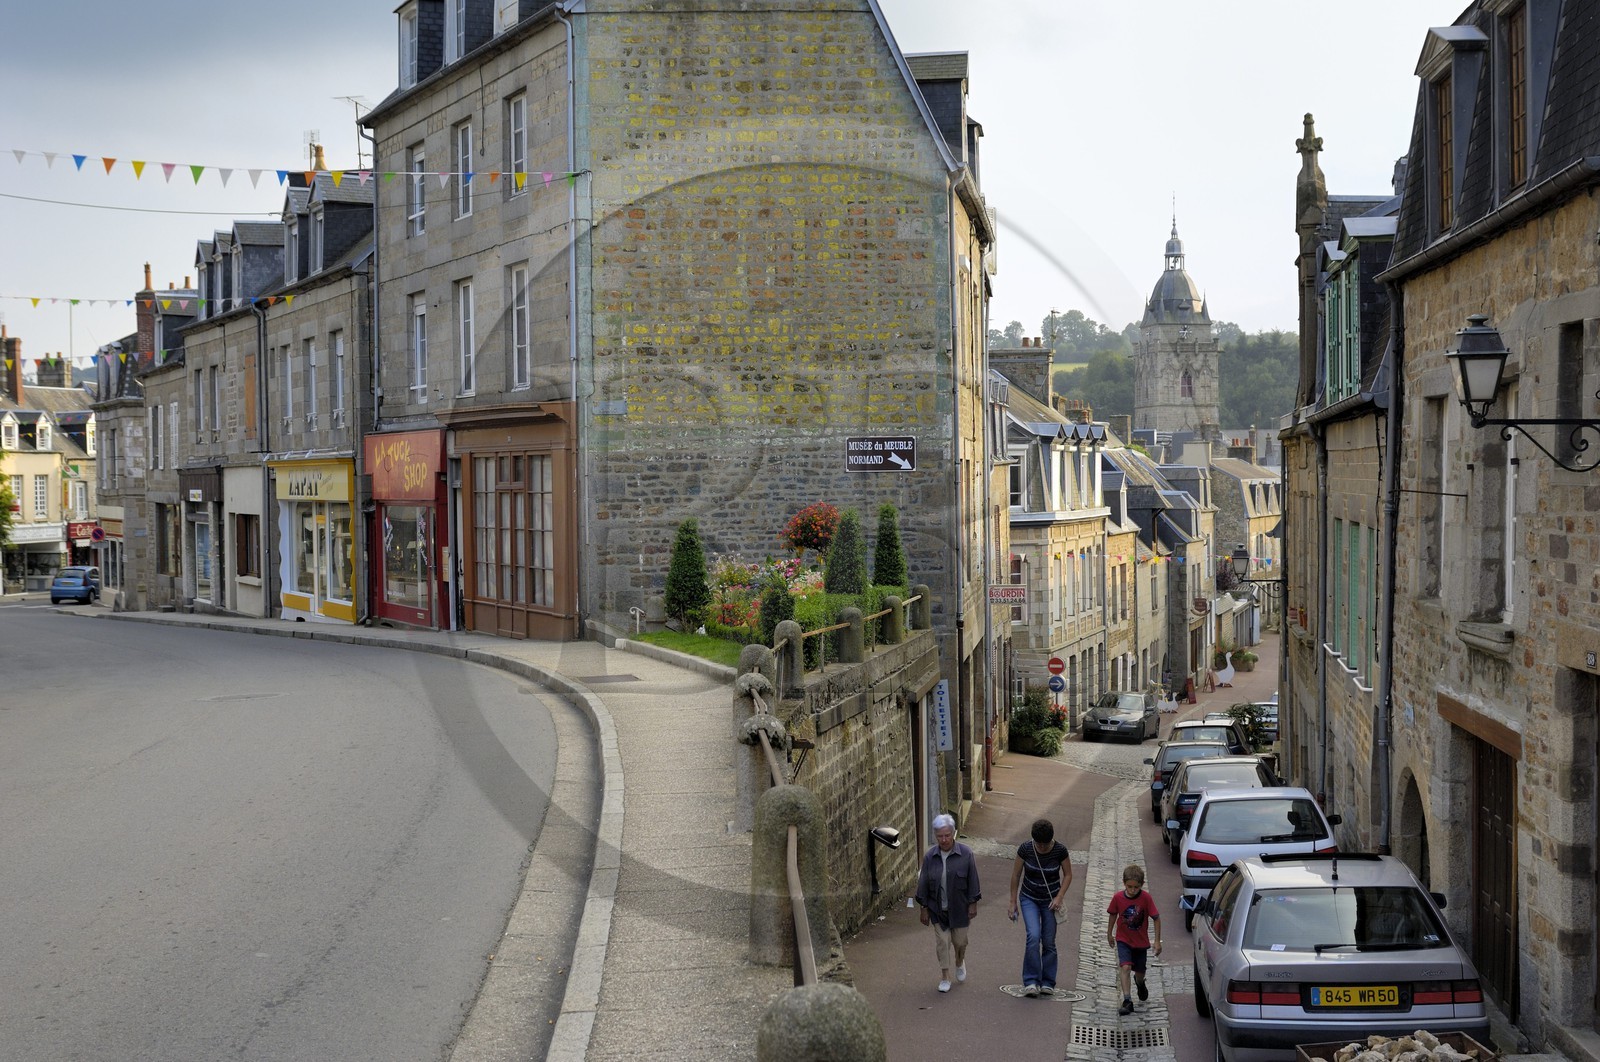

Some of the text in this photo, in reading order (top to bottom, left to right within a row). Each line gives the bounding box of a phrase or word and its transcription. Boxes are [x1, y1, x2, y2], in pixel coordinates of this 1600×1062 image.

[848, 439, 913, 451] MUSÉE du MEUBLE
[374, 440, 411, 468] LA TUCK
[848, 455, 884, 465] NORMAND
[403, 462, 428, 492] SHOP
[989, 588, 1026, 598] BOURDIN
[936, 684, 947, 737] TOILETTES
[1325, 989, 1396, 1003] 845 WR 50
